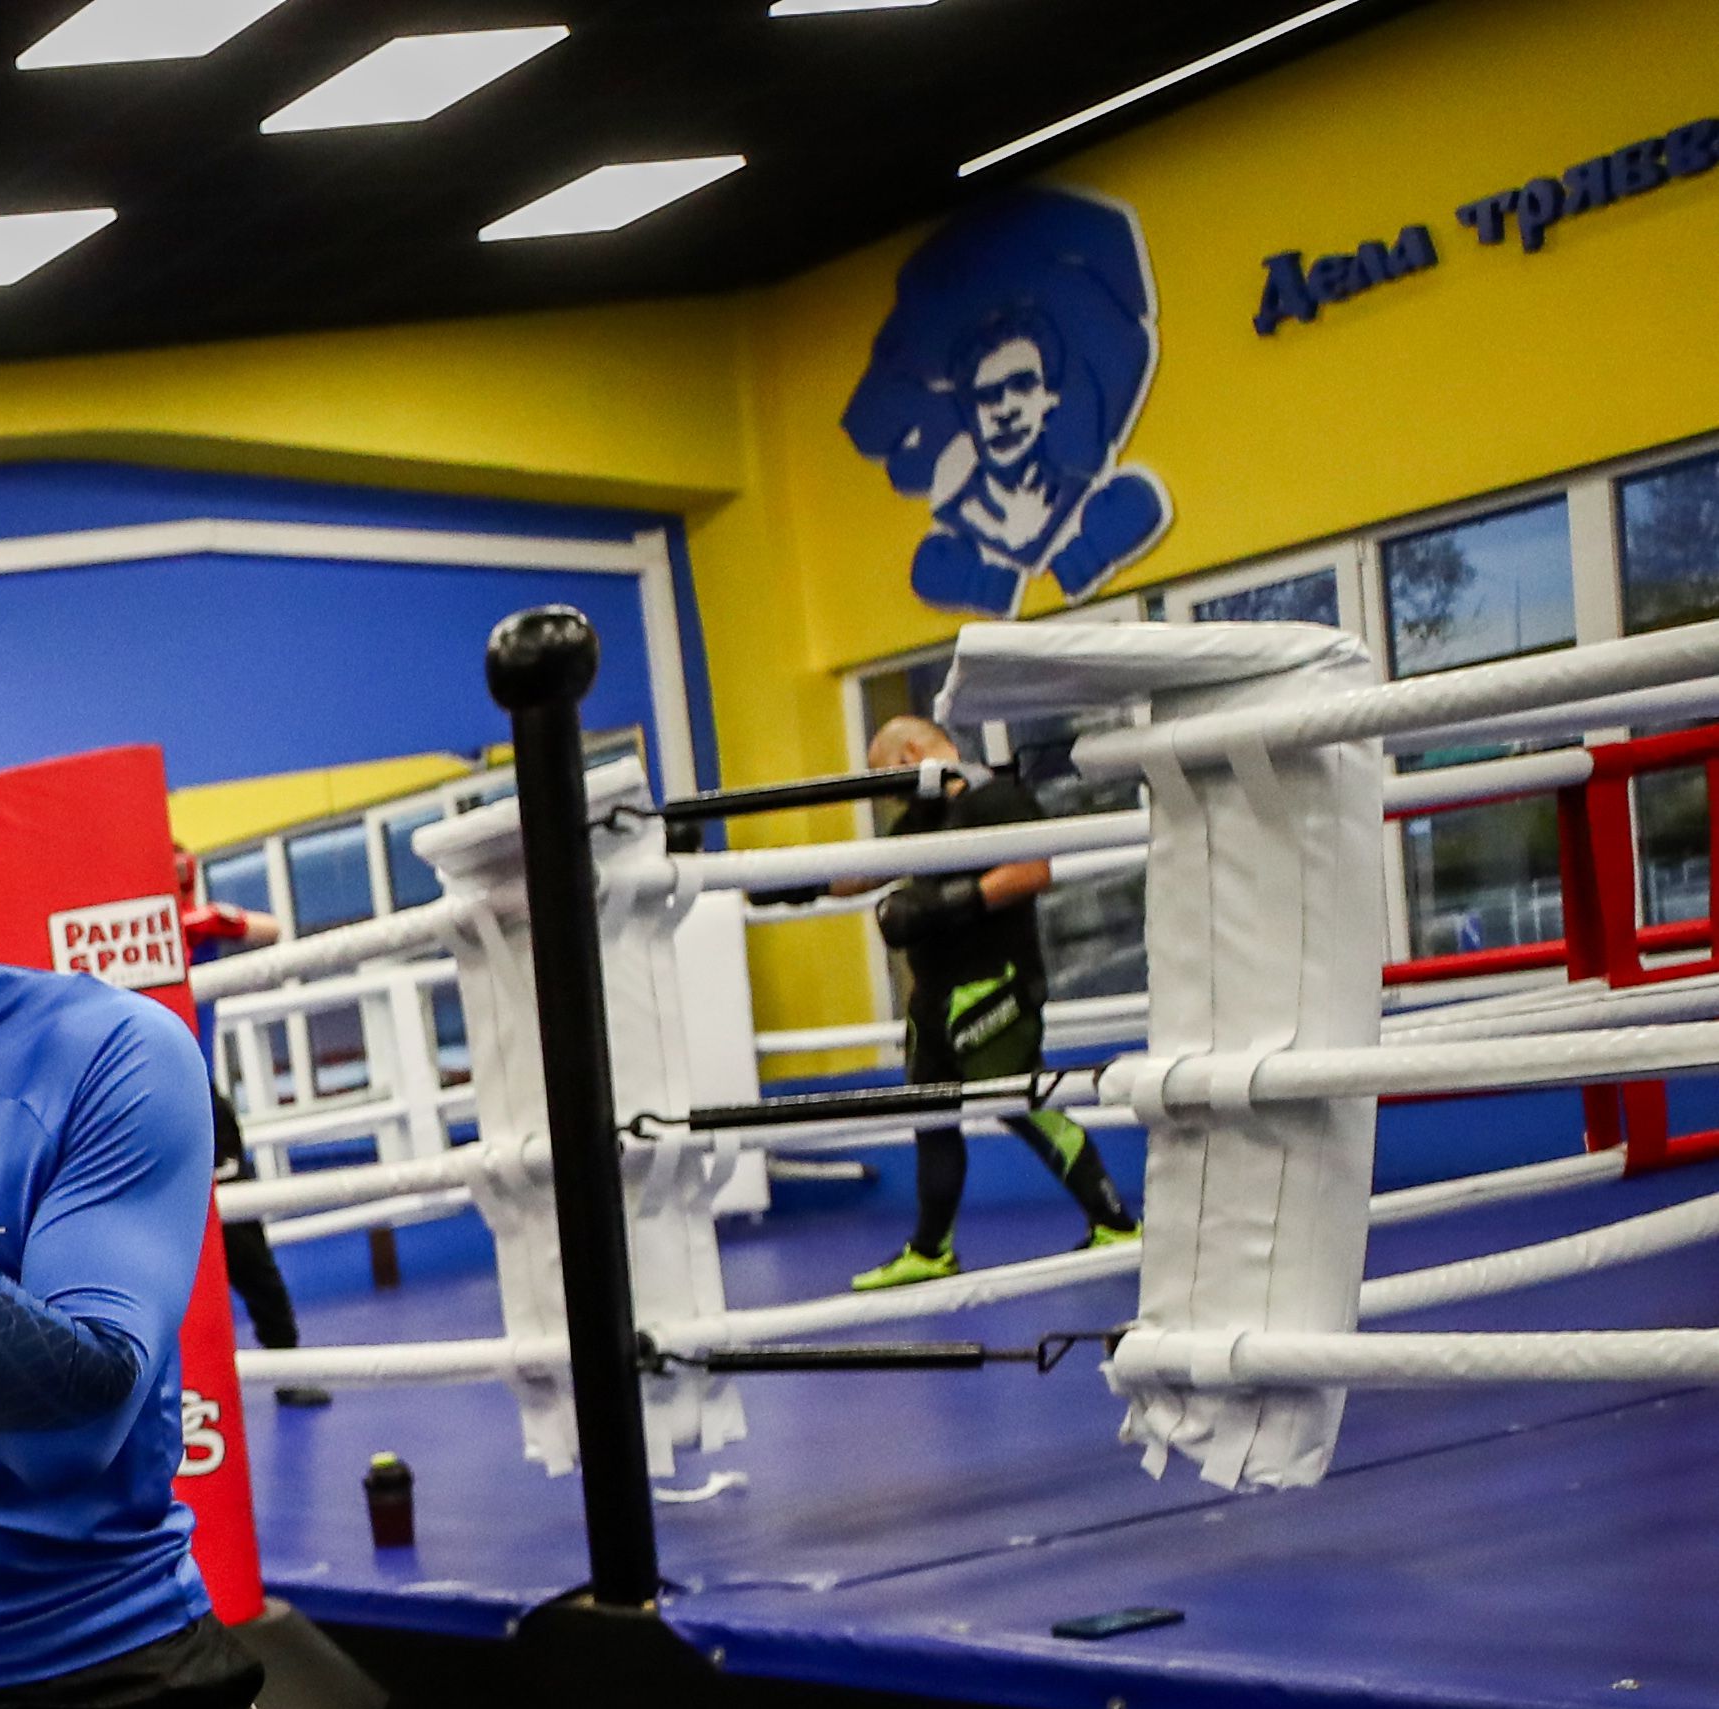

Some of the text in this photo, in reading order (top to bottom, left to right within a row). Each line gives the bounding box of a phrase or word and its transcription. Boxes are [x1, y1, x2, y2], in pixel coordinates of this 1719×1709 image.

[1253, 223, 1439, 337] Дела
[65, 903, 173, 948] PAFFEN
[69, 940, 176, 974] SPORT
